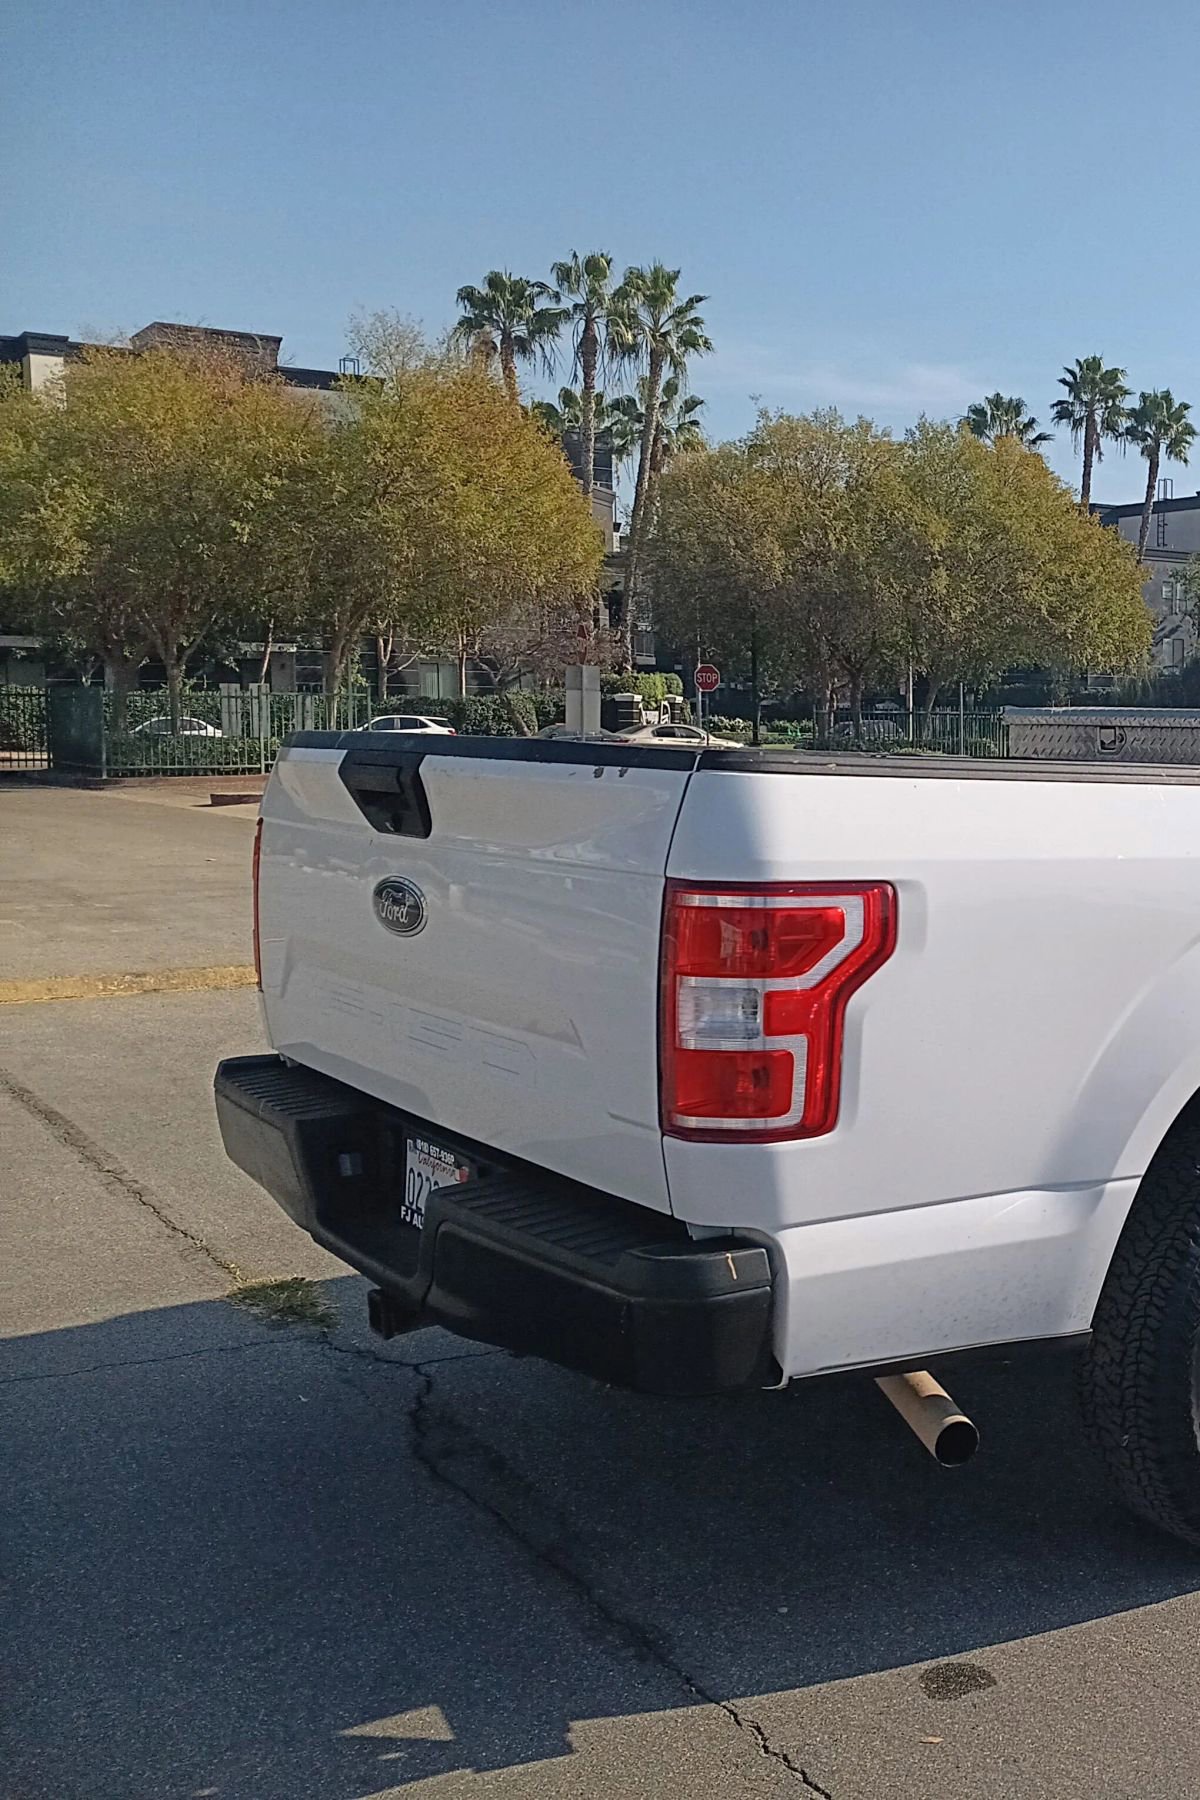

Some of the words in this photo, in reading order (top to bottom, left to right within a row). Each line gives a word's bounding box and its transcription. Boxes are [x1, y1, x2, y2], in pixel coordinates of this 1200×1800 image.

[697, 673, 718, 683] STOP
[379, 888, 410, 923] Ford
[400, 1206, 412, 1222] FJ
